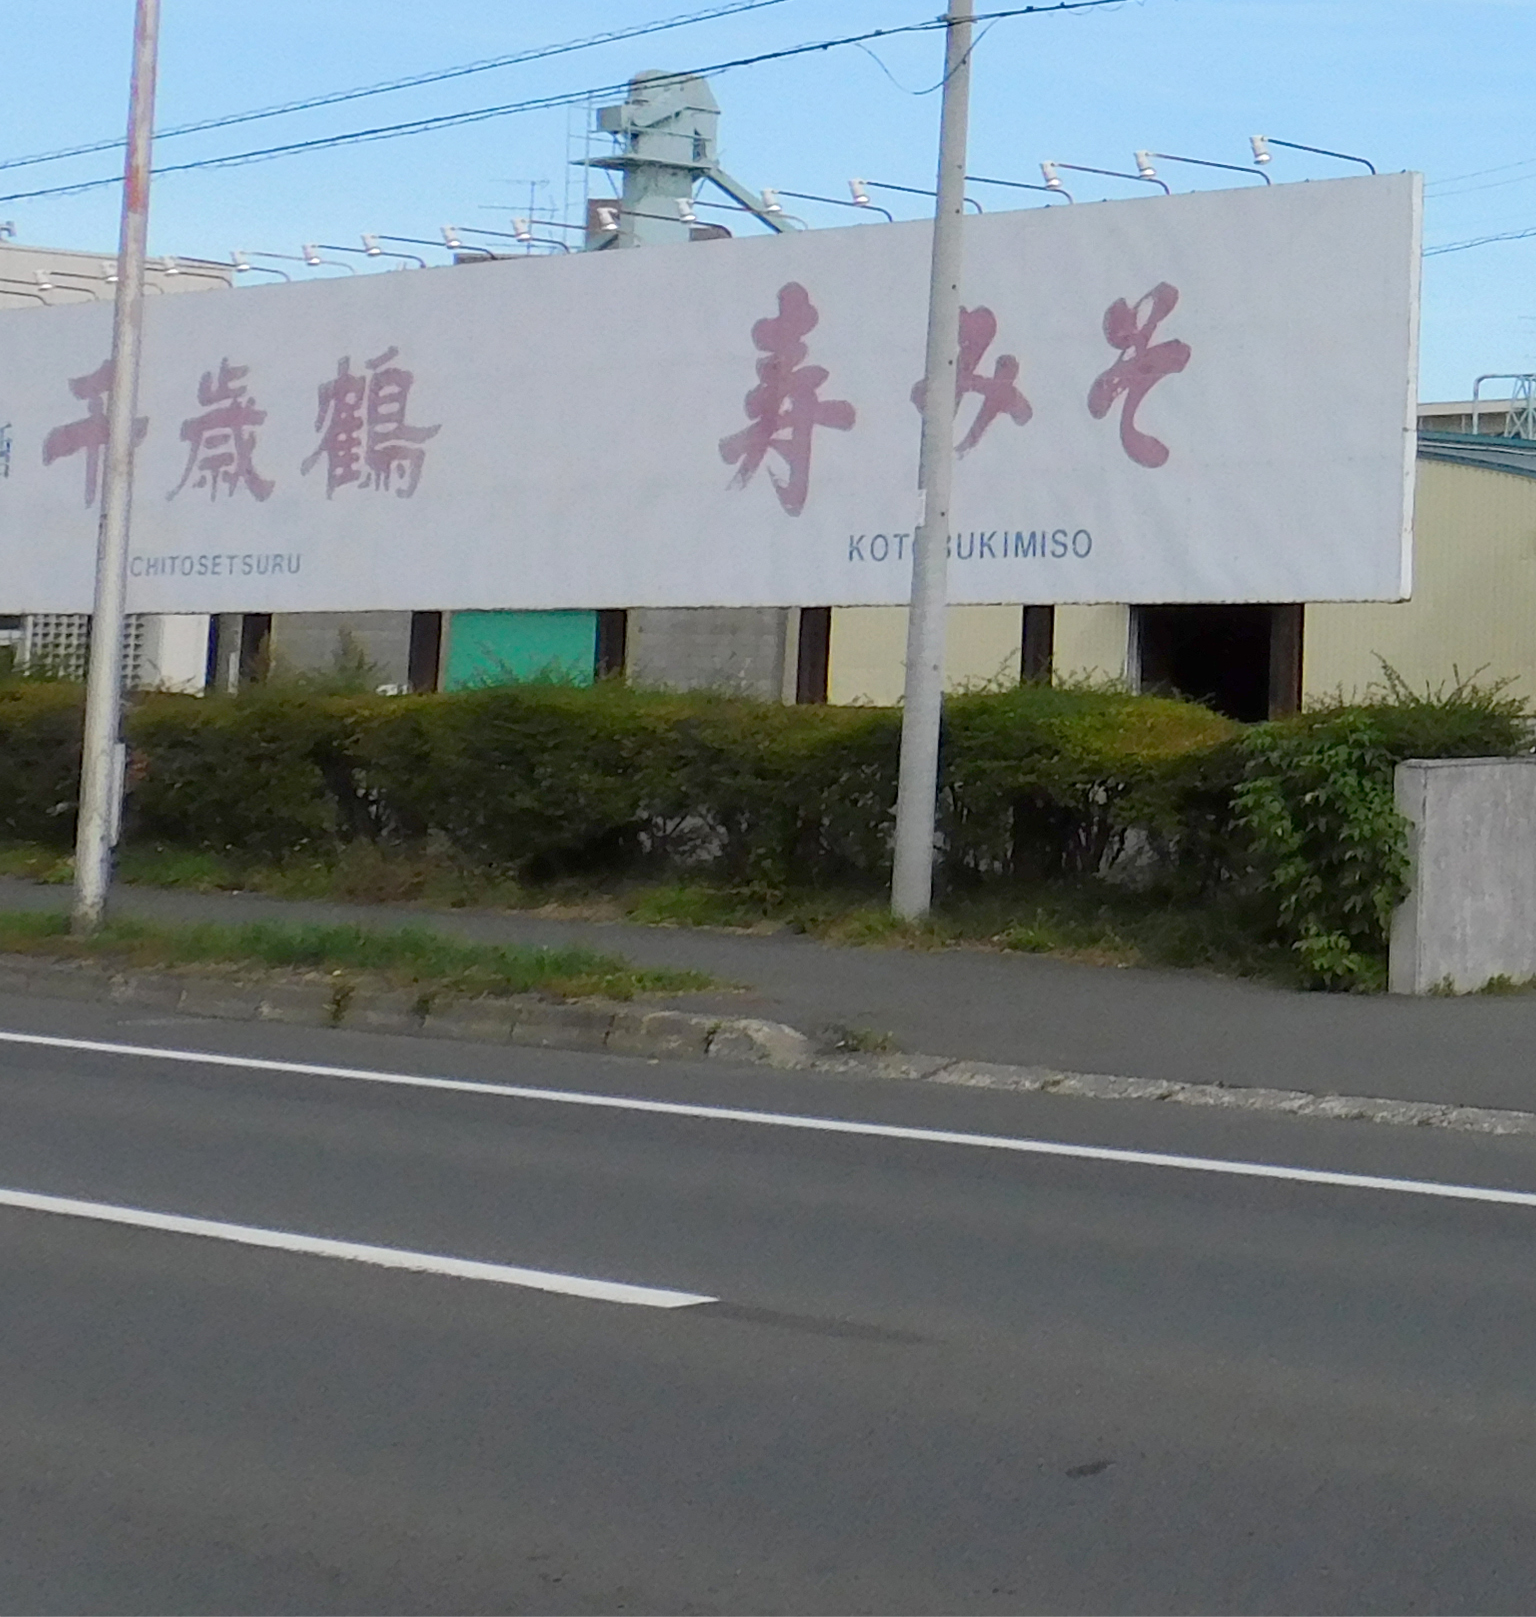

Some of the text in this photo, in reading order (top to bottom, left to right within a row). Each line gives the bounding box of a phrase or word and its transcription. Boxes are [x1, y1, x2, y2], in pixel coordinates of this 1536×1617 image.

[42, 345, 442, 510] 千歳鶴
[718, 281, 1192, 518] 寿みそ
[129, 553, 302, 578] CHITOSETSURU
[848, 528, 1093, 563] KOTUKIMISO
